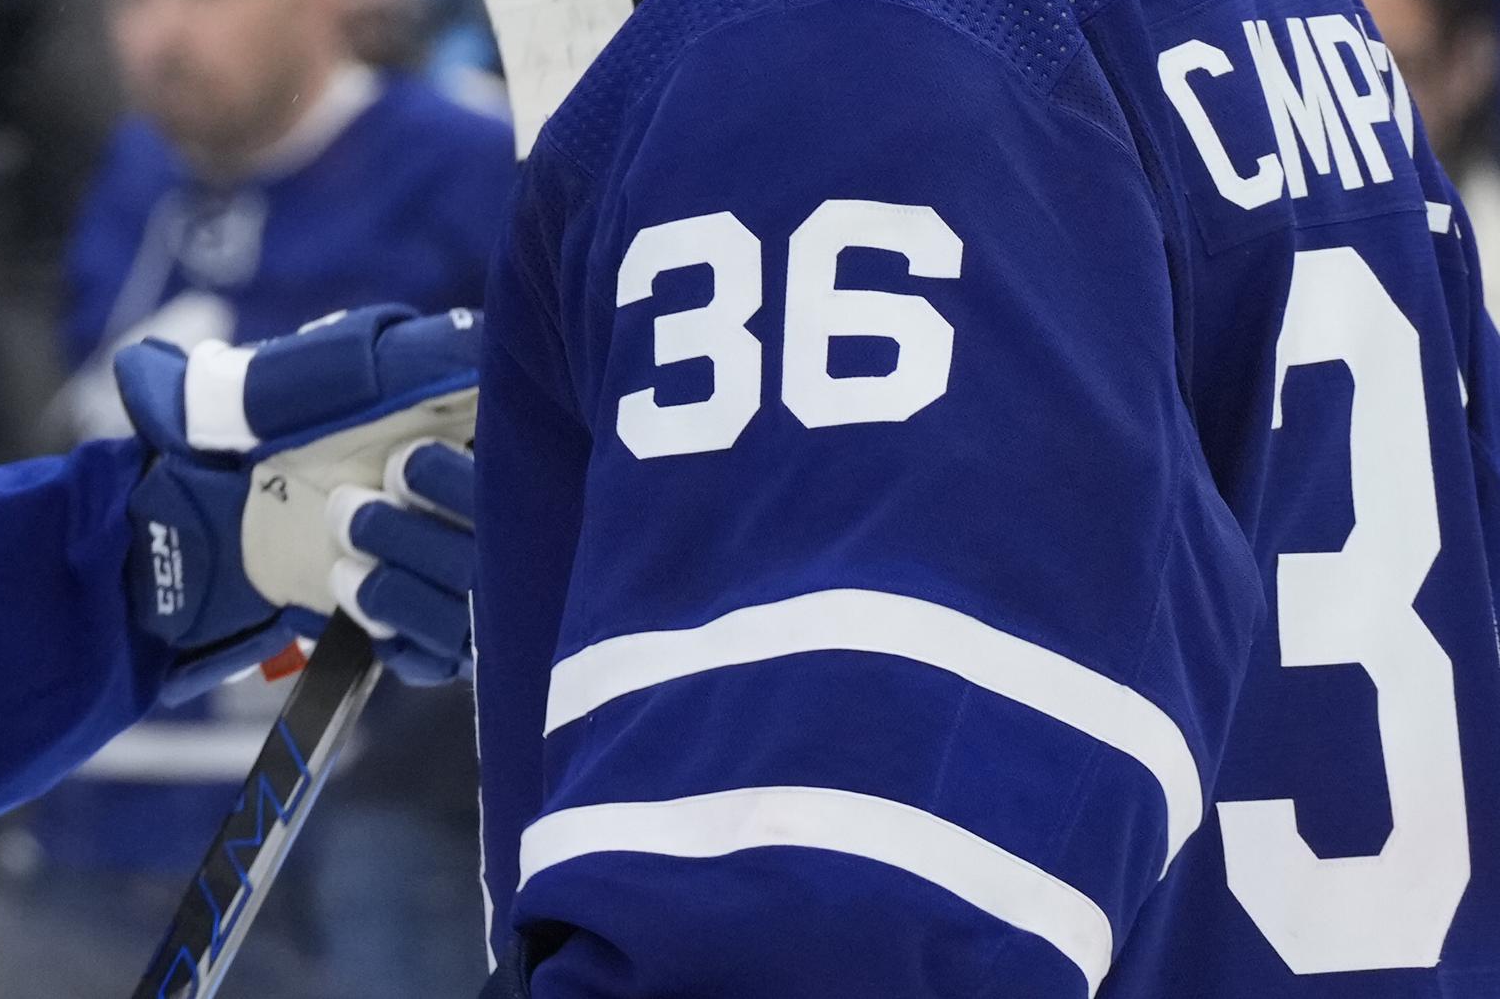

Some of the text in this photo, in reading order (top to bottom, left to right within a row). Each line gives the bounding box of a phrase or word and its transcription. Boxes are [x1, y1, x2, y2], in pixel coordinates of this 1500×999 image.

[616, 199, 964, 461] 36
[147, 520, 175, 615] CCM
[1216, 246, 1471, 977] 3
